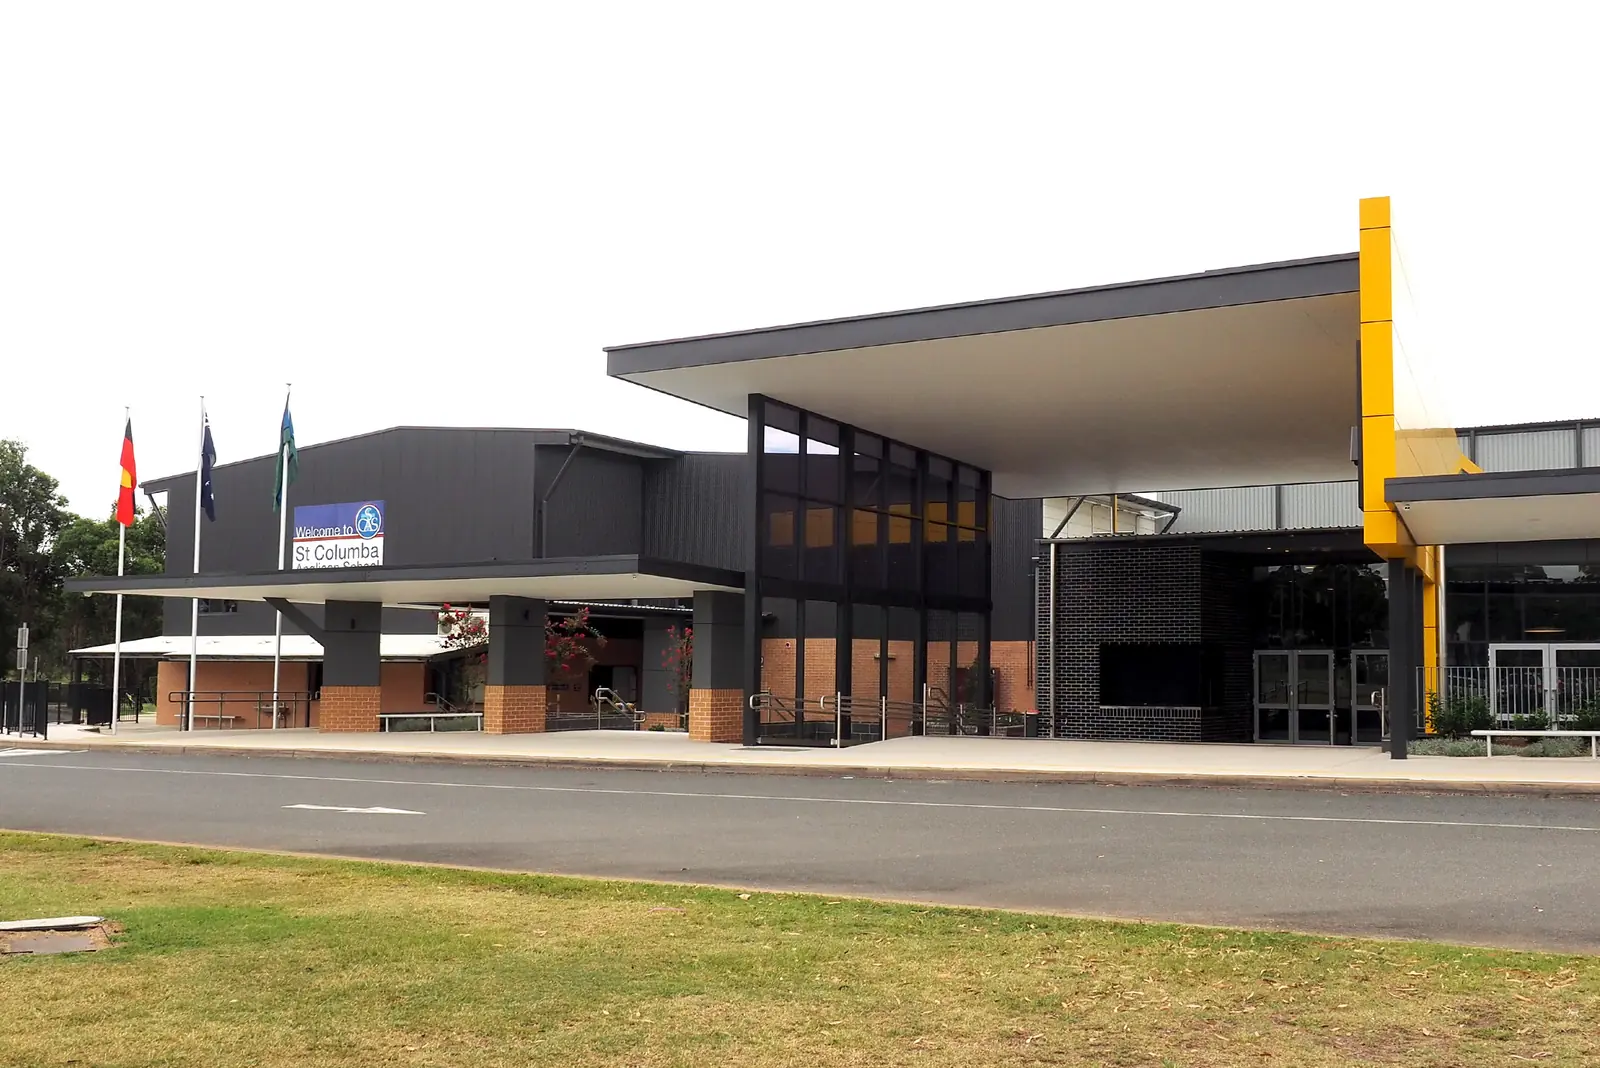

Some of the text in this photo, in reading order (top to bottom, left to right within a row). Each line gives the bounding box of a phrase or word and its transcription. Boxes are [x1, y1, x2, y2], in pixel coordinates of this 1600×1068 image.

[296, 524, 354, 537] Welcome to
[296, 543, 379, 561] St Columba
